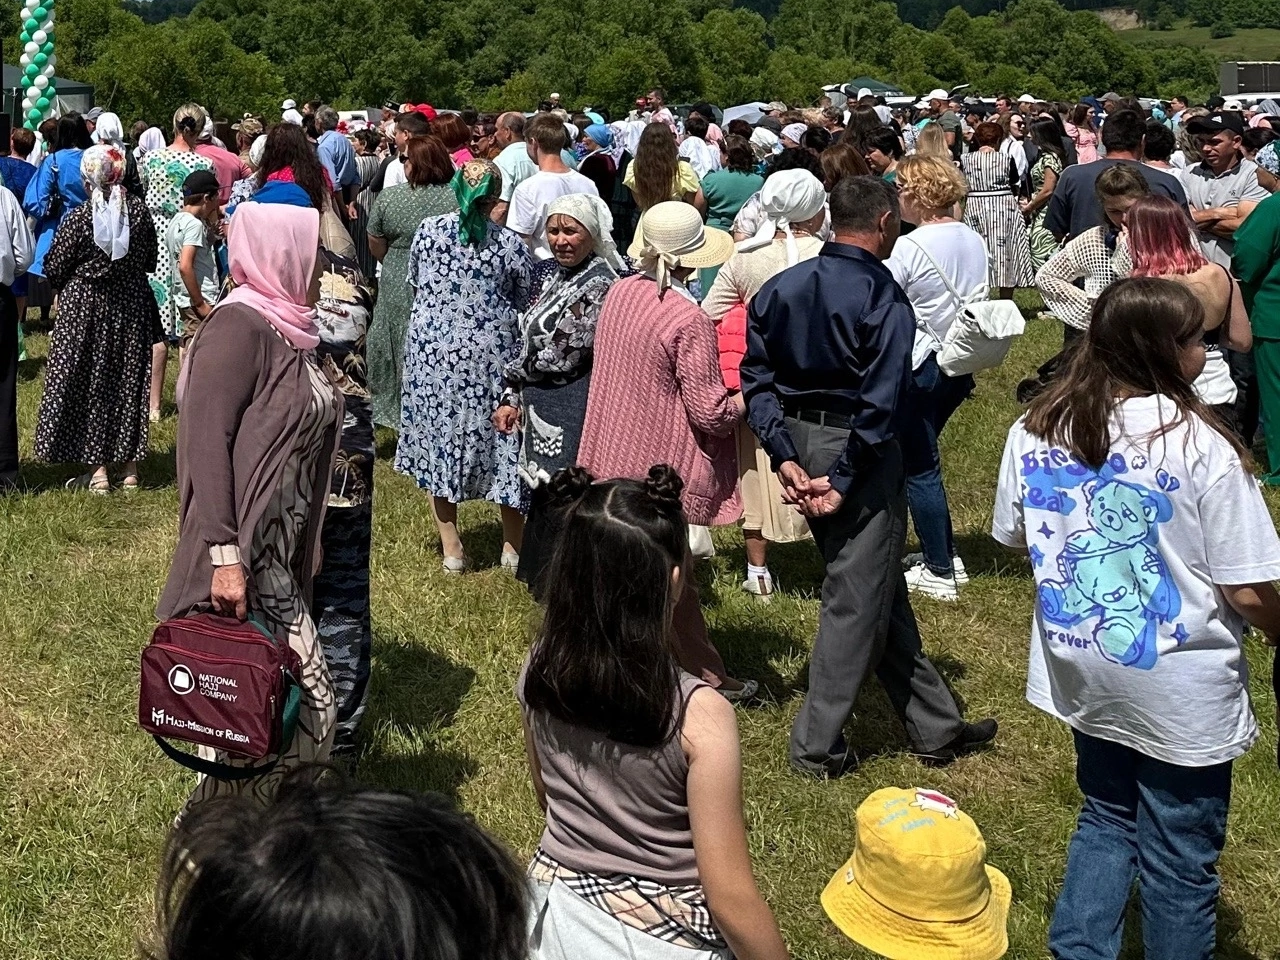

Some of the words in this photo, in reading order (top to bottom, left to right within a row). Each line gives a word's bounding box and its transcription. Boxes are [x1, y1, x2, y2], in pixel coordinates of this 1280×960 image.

[1022, 484, 1068, 513] ear
[199, 673, 238, 688] NATIONAL
[199, 681, 219, 691] HAJJ
[200, 688, 238, 702] COMPANY
